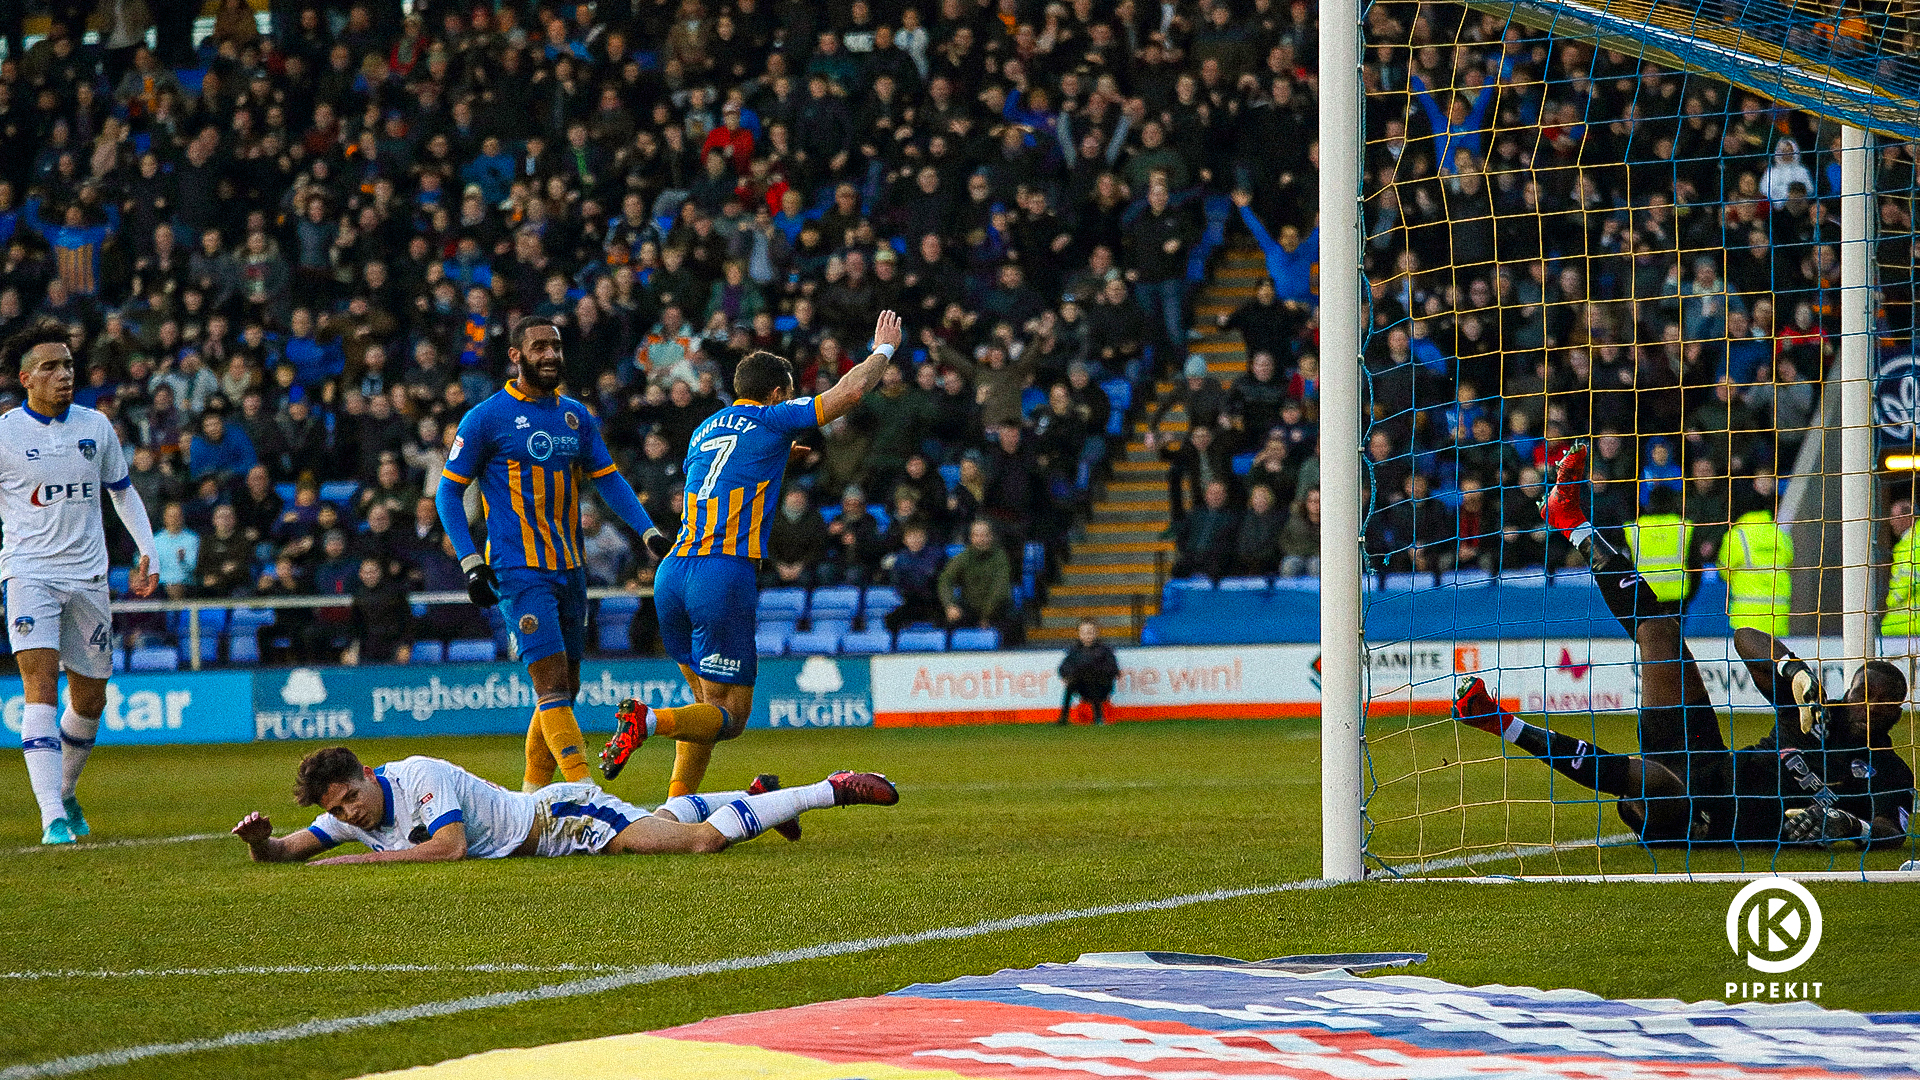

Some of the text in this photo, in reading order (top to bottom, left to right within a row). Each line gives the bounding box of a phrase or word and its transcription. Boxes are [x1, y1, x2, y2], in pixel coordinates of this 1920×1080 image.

[691, 414, 757, 448] WHALLEY
[696, 434, 738, 501] 7
[45, 482, 93, 501] PFE
[910, 665, 1056, 701] Another
[769, 699, 872, 727] PUGHS
[1528, 692, 1623, 711] DARWIN
[256, 711, 355, 740] PUGHS
[1785, 754, 1840, 808] PFE
